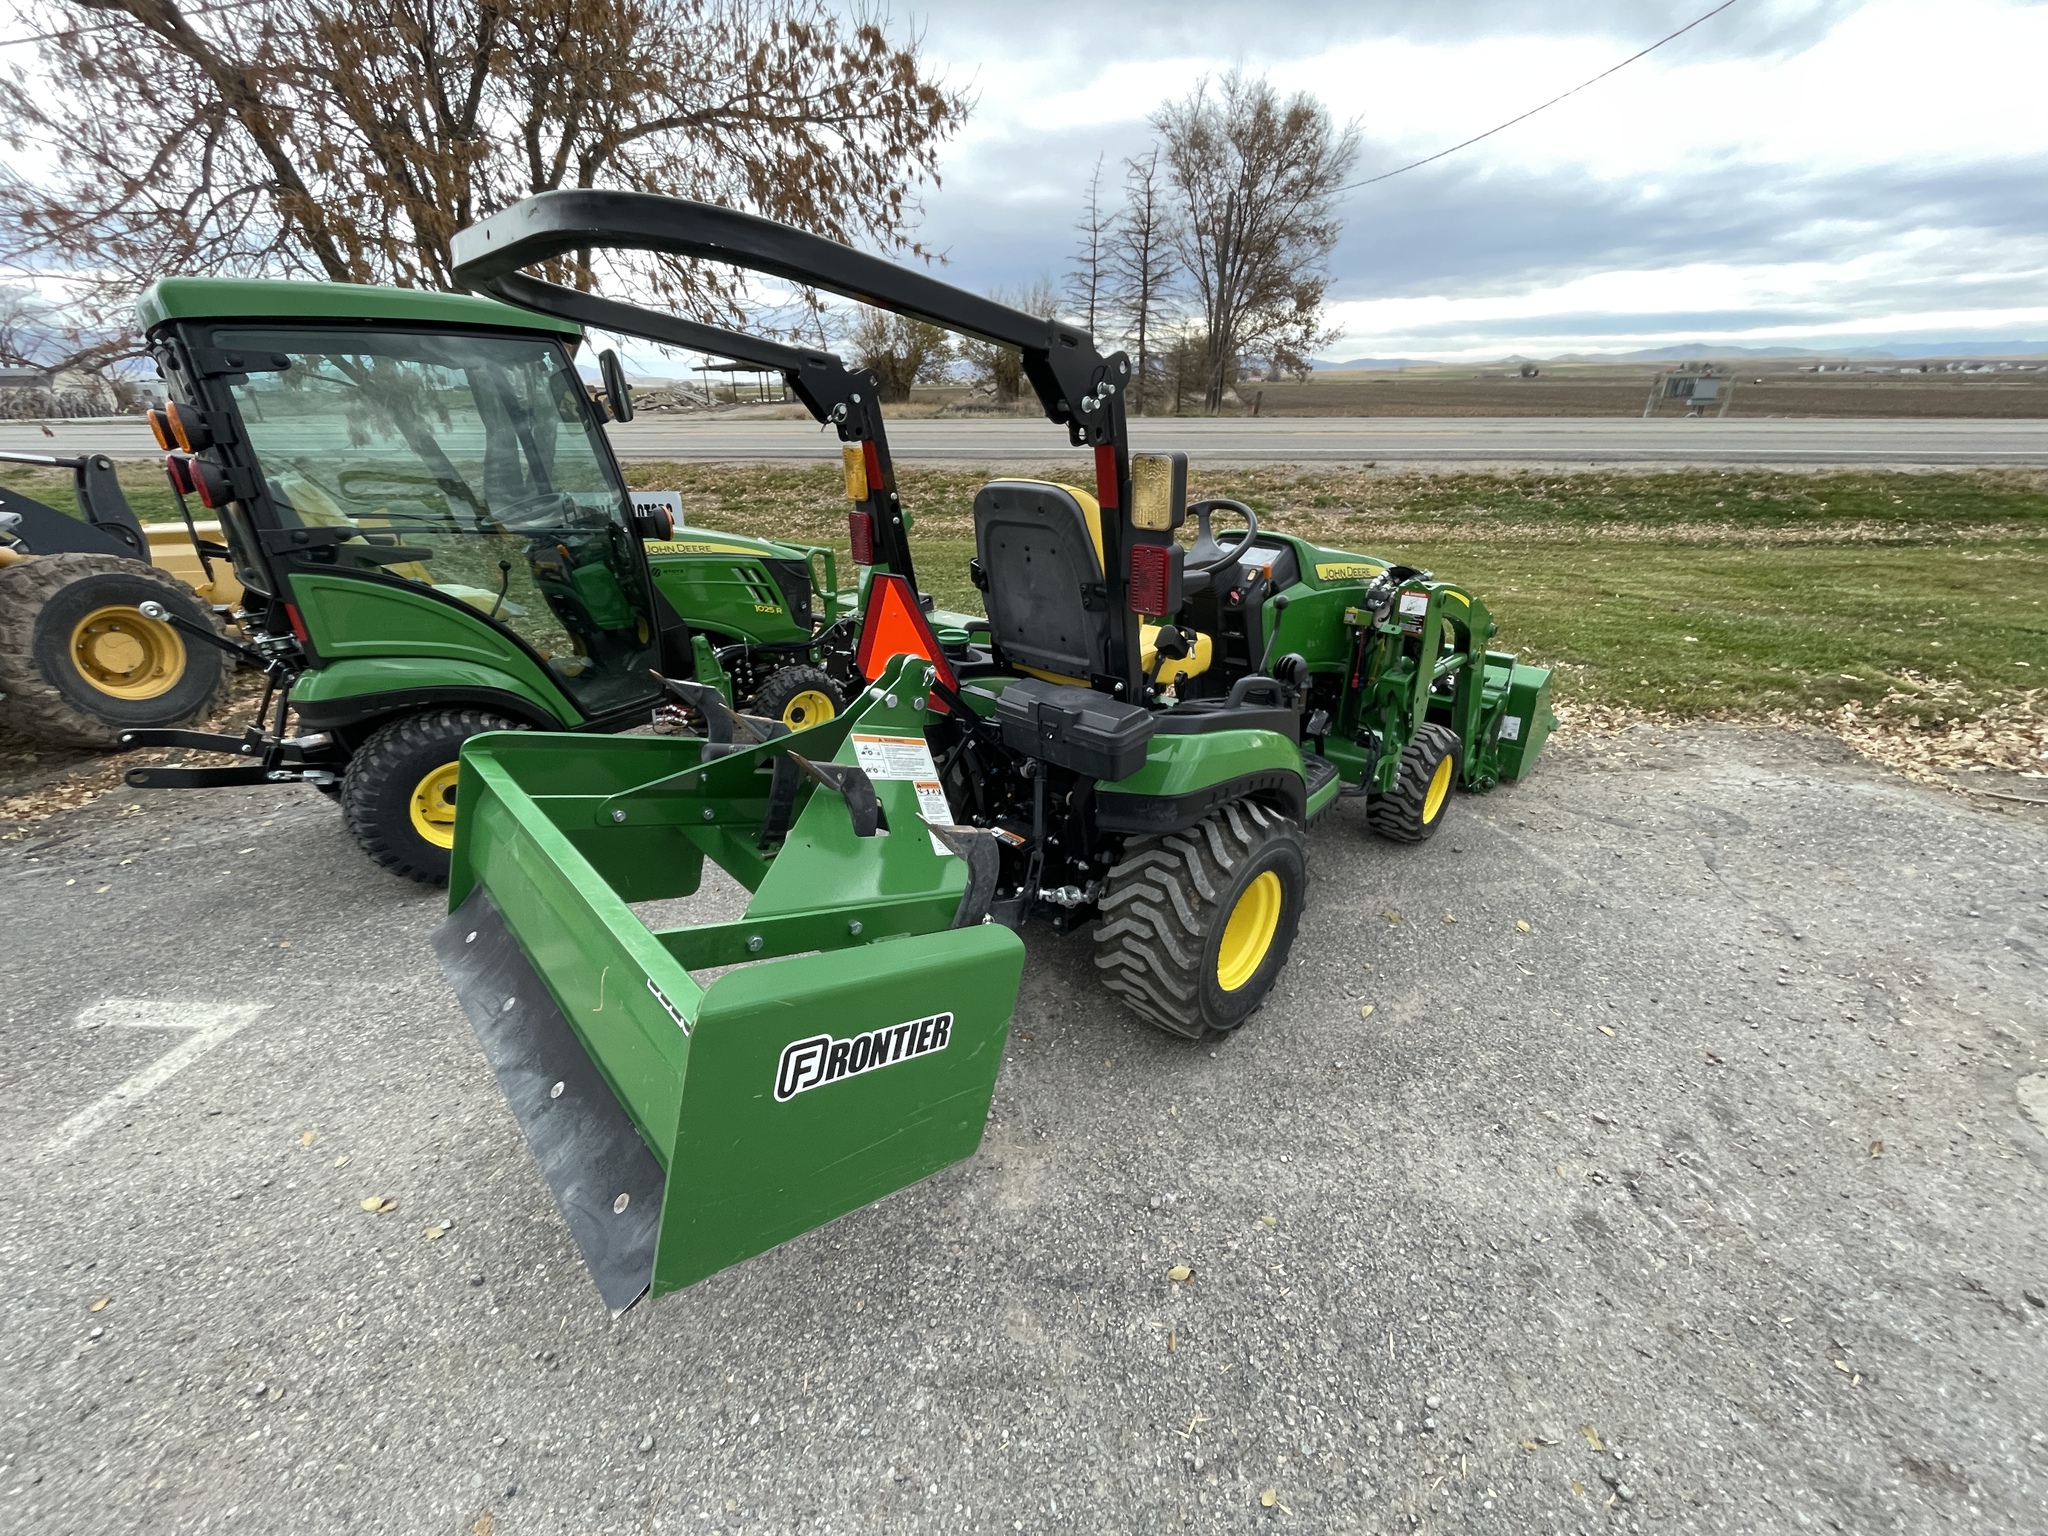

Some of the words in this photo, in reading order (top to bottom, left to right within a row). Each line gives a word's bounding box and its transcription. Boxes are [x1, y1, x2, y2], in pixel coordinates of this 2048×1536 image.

[646, 545, 675, 554] JOHN
[676, 544, 713, 553] DEERE
[1324, 567, 1346, 579] JOHN
[1346, 566, 1371, 577] DEERE
[754, 604, 775, 614] 1025
[776, 607, 783, 615] R
[777, 1014, 952, 1099] FRONTIER
